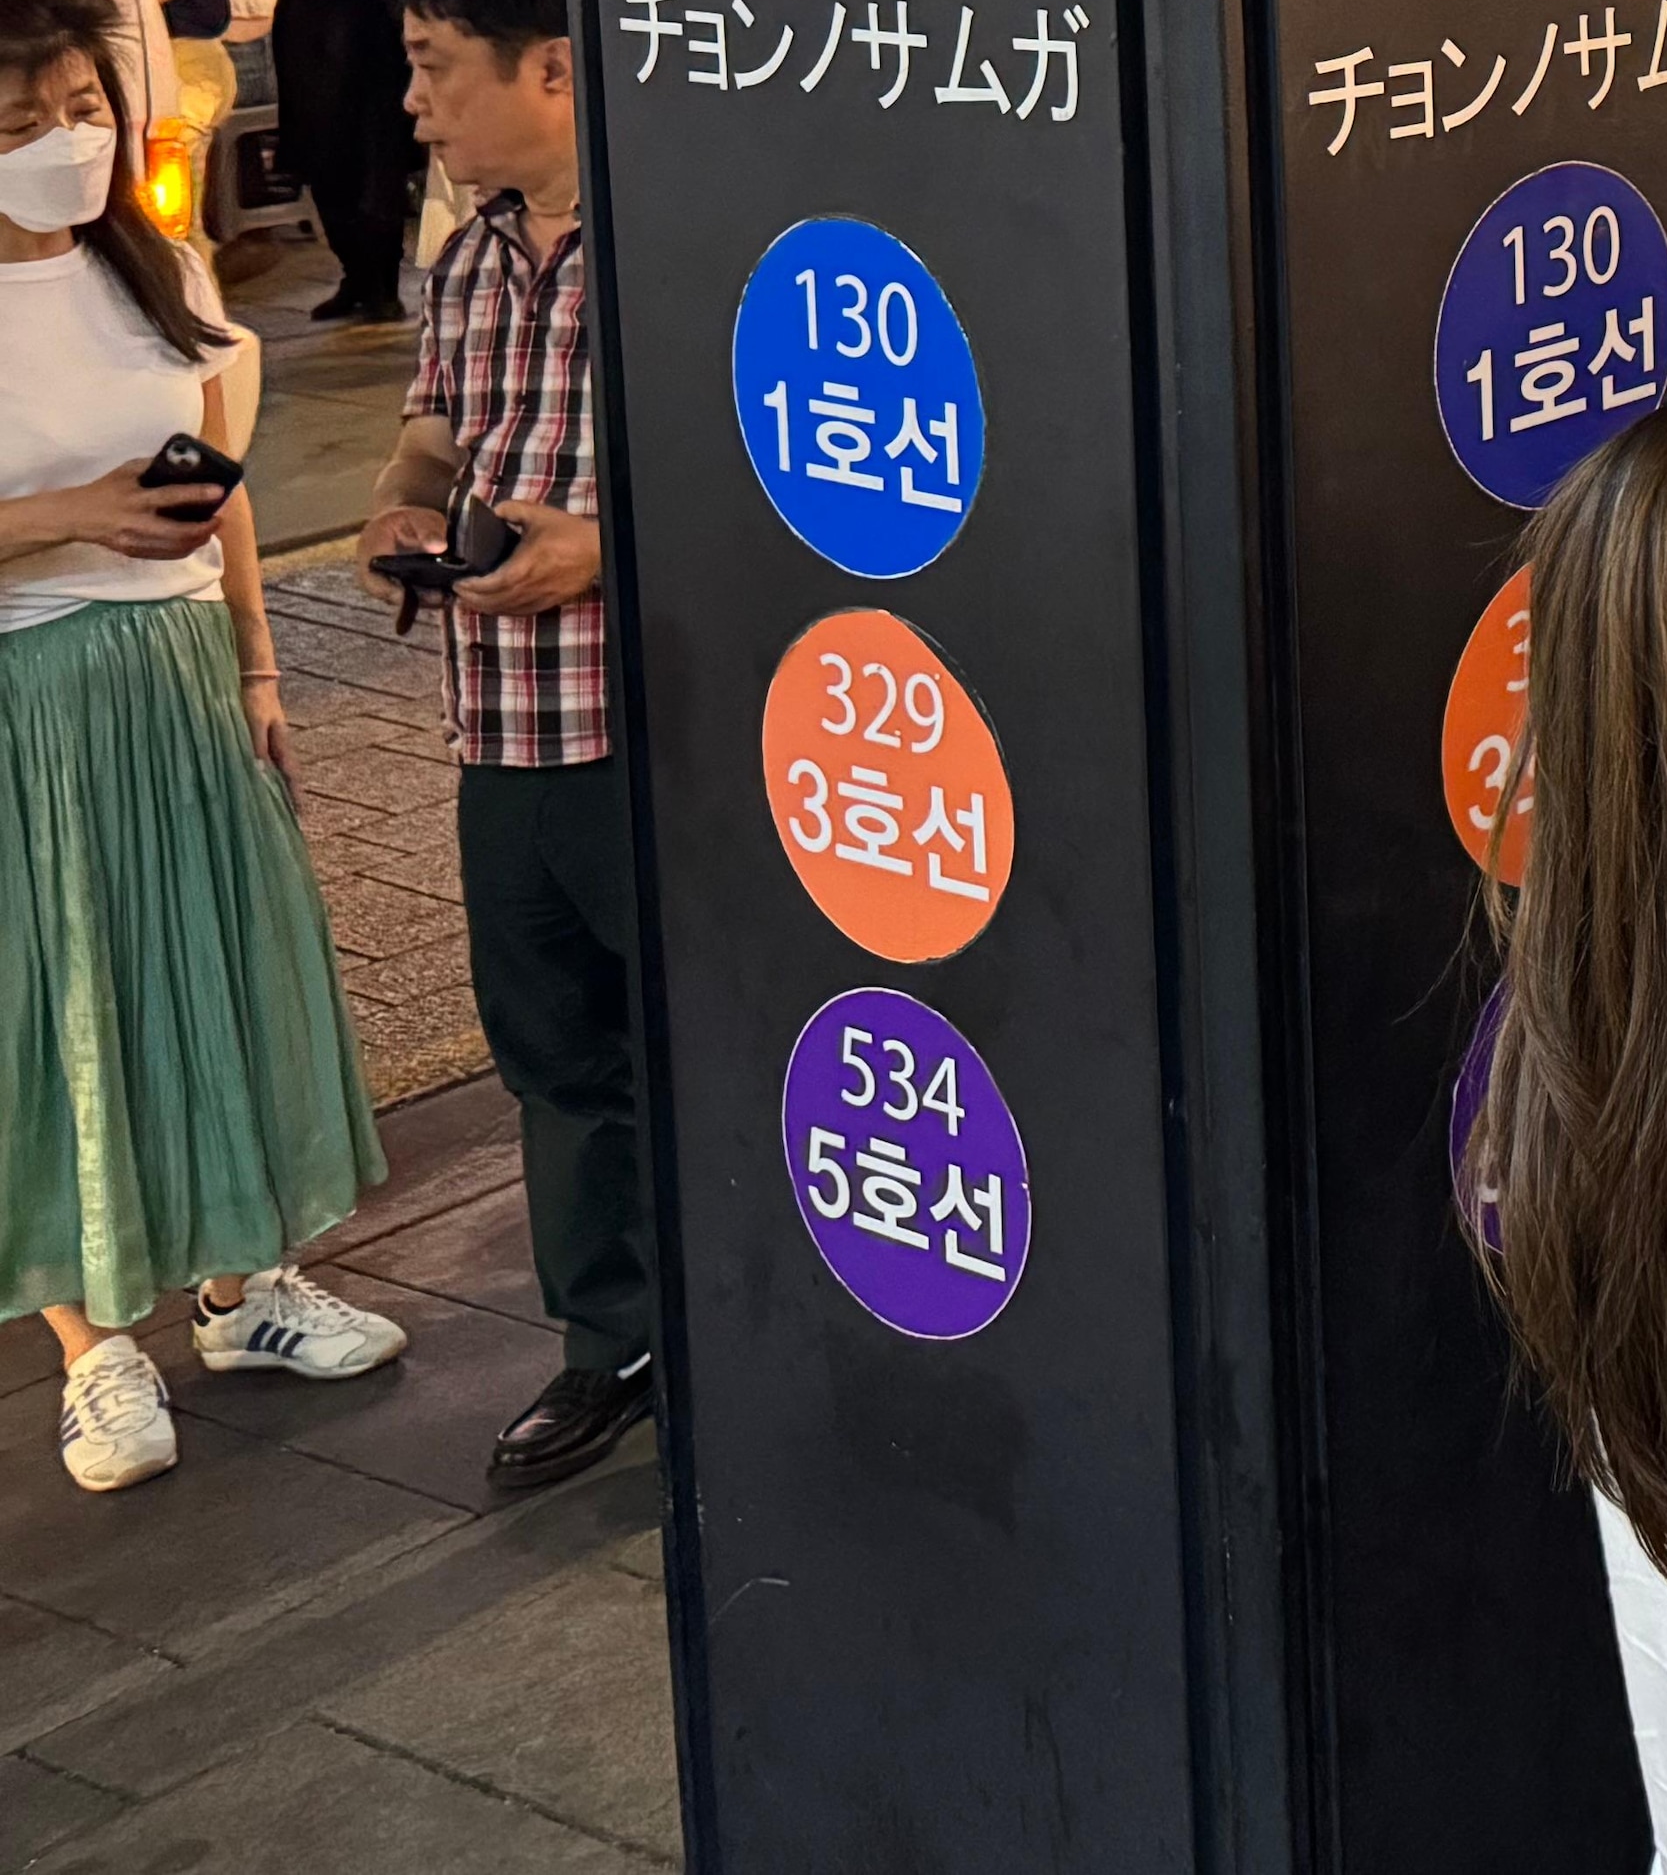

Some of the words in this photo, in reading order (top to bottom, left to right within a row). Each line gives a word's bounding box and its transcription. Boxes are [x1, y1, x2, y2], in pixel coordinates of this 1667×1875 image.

[793, 266, 920, 367] 130
[1501, 204, 1623, 307] 130
[1465, 291, 1661, 444] 1호선
[761, 377, 965, 516] 1호선
[819, 649, 947, 754] 329
[784, 756, 991, 905] 3호선
[839, 1024, 967, 1137] 534
[804, 1123, 1008, 1285] 5호선
